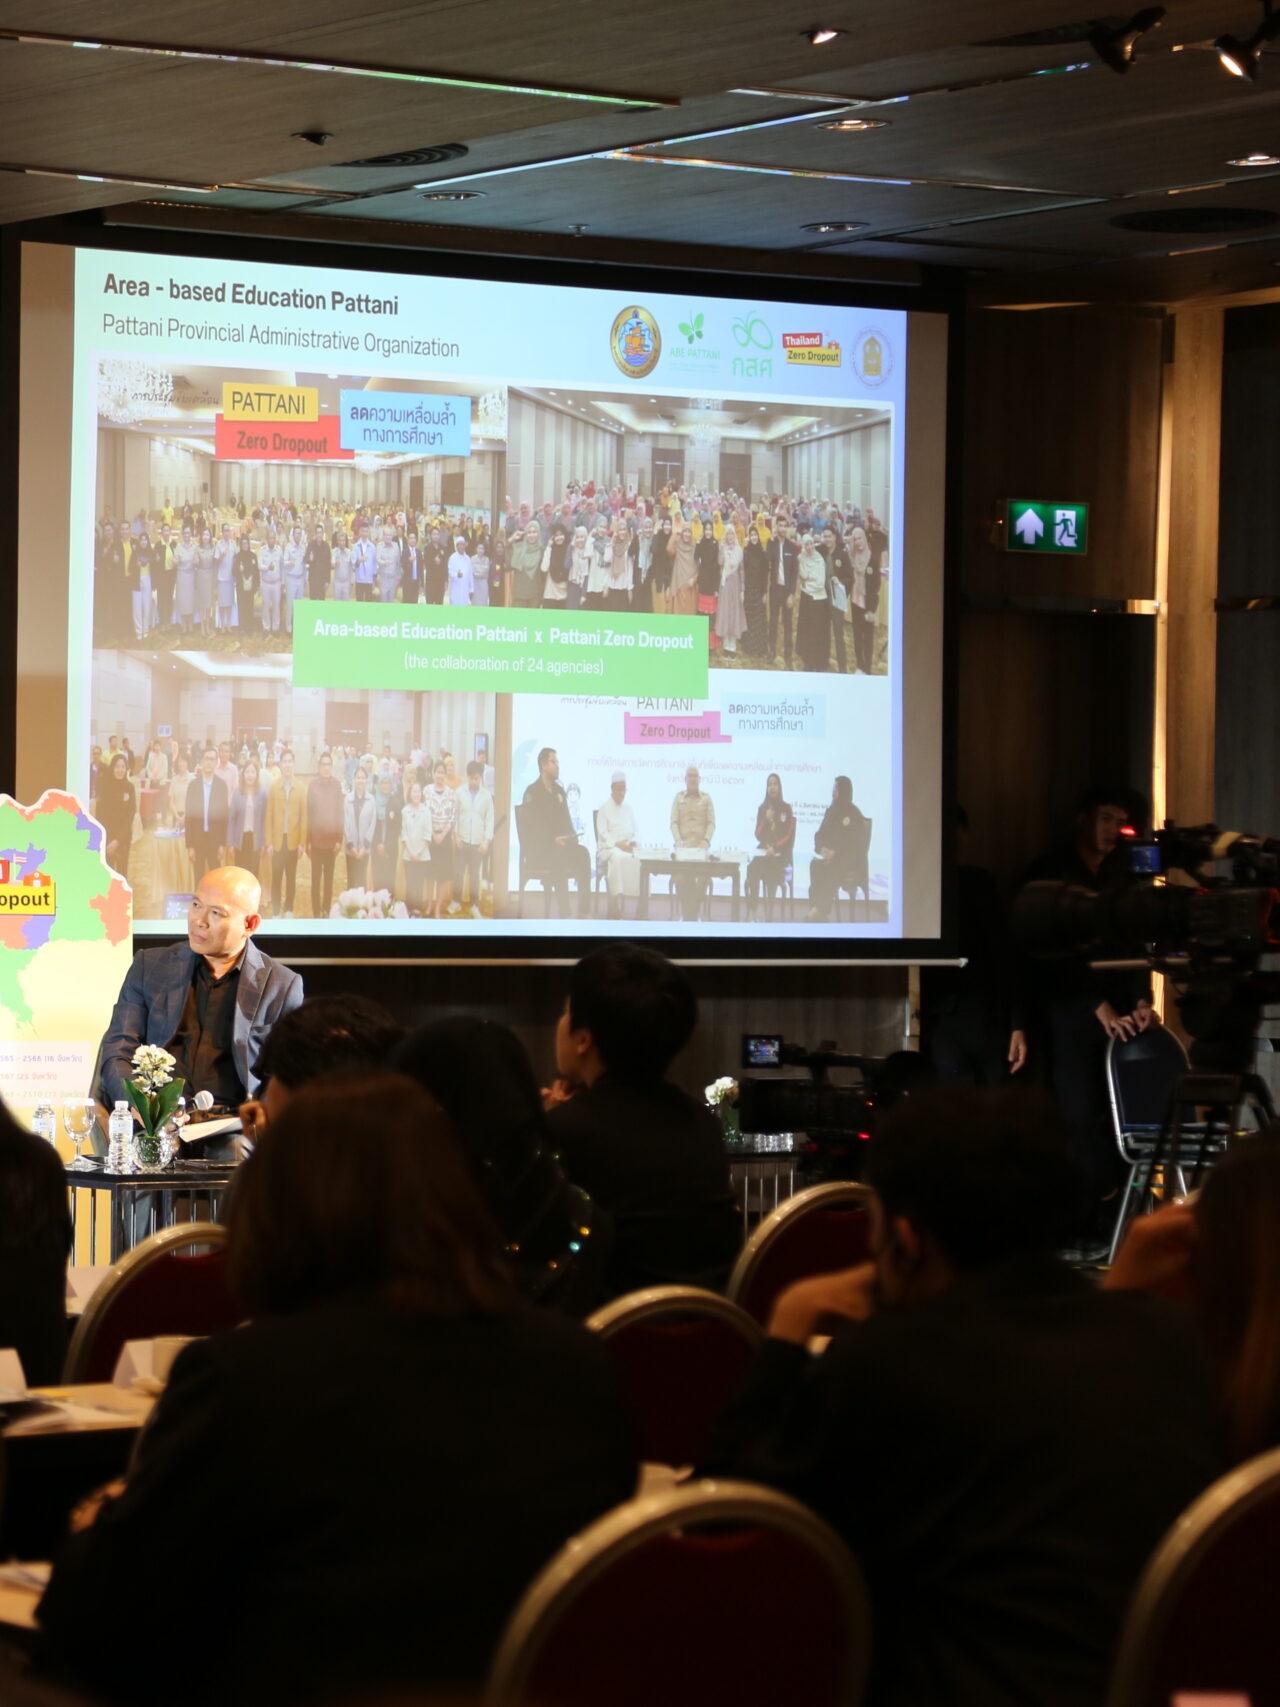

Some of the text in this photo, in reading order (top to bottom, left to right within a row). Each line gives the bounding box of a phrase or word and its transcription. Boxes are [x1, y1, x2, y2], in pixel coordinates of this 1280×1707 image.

[104, 274, 398, 315] Area based Education Pattani
[103, 314, 460, 358] Pattani Provincial Administrative Organization
[785, 336, 820, 346] Thailand
[788, 351, 840, 363] Zero Dropout
[732, 358, 772, 377] กสศ
[232, 391, 306, 415] PATTANI
[350, 403, 456, 426] ลดความเหลื่อมล้ำ
[237, 430, 328, 454] Zero Dropout
[363, 427, 443, 446] ทางการศึกษา
[314, 619, 693, 651] Area-based Education Pattani x Pattani Zero Dropout
[404, 651, 604, 676] (the collaboration of 24 agencies)
[637, 697, 693, 711] PATTANI
[729, 699, 814, 716] ลดความเหลื่อมล้ำ
[640, 724, 711, 740] Zero Dropout
[739, 719, 803, 731] ทางการศึกษา
